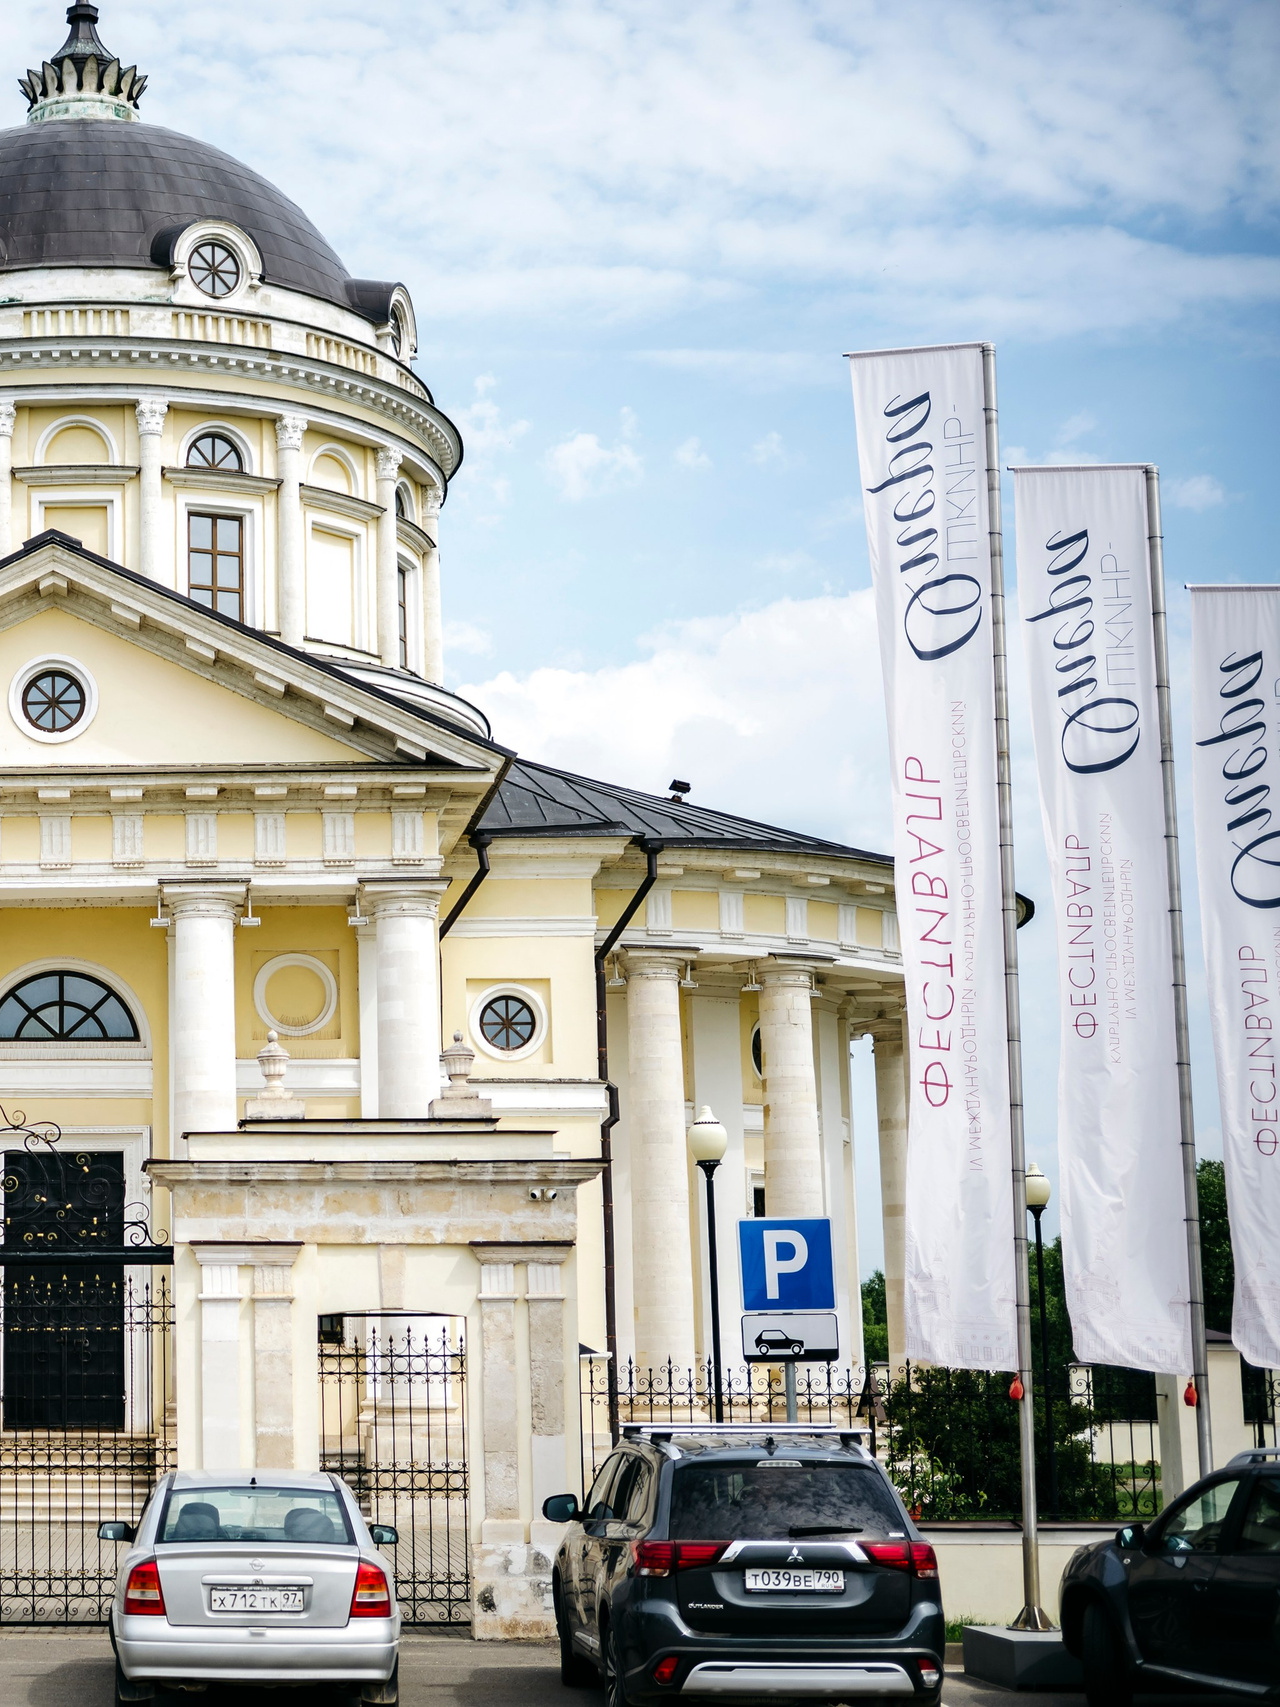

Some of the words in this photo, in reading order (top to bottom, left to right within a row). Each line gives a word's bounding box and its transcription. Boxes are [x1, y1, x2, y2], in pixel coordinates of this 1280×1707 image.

[762, 1229, 809, 1300] P
[815, 1571, 839, 1583] 790
[282, 1592, 297, 1604] 97
[688, 1601, 724, 1610] OUTLANDER
